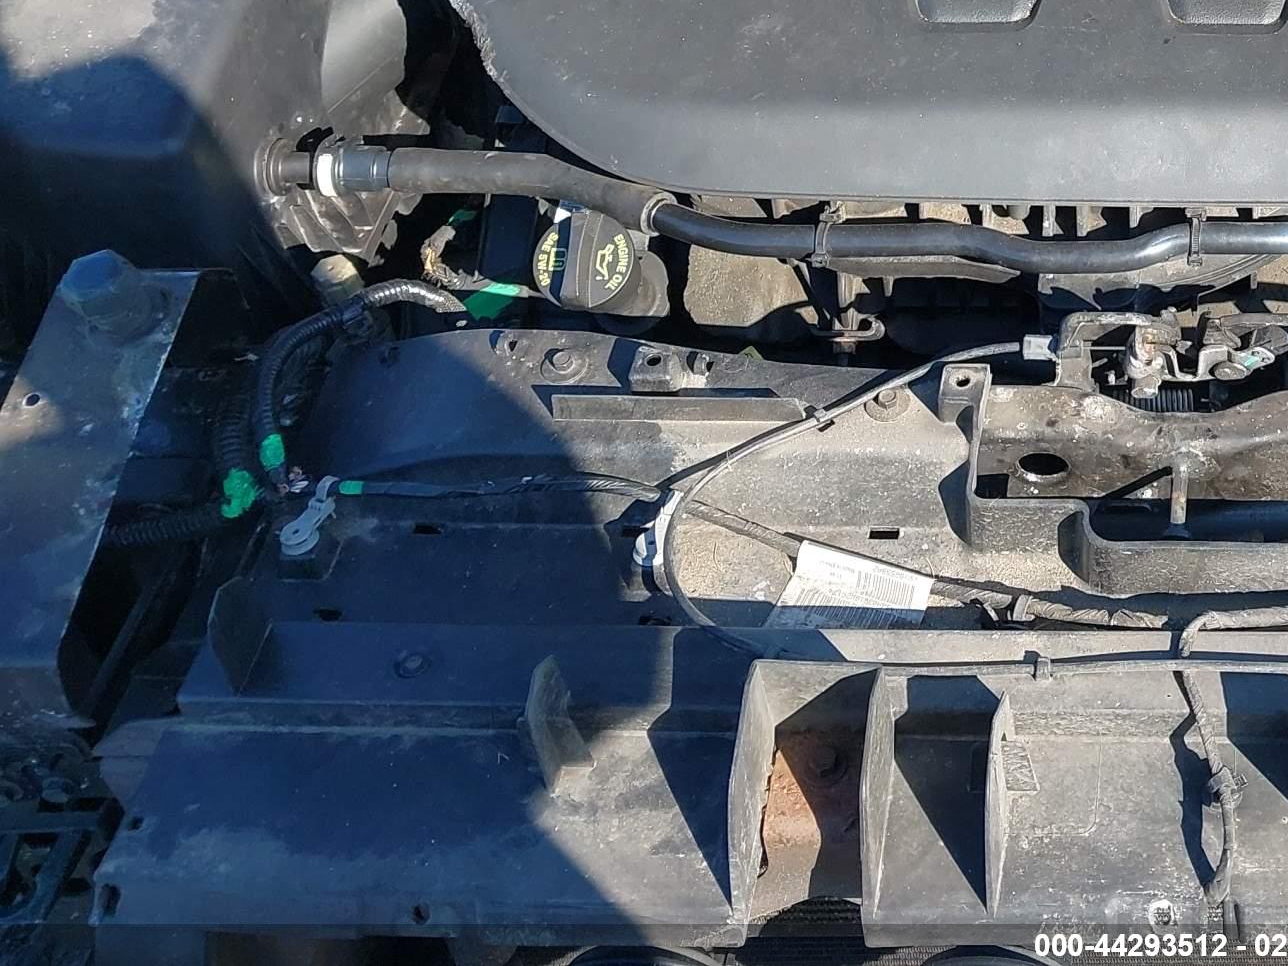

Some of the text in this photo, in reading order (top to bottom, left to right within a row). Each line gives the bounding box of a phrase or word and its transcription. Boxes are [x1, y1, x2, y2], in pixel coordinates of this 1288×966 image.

[537, 232, 559, 287] SAE 5W-20
[604, 233, 629, 291] ENGINE OIL
